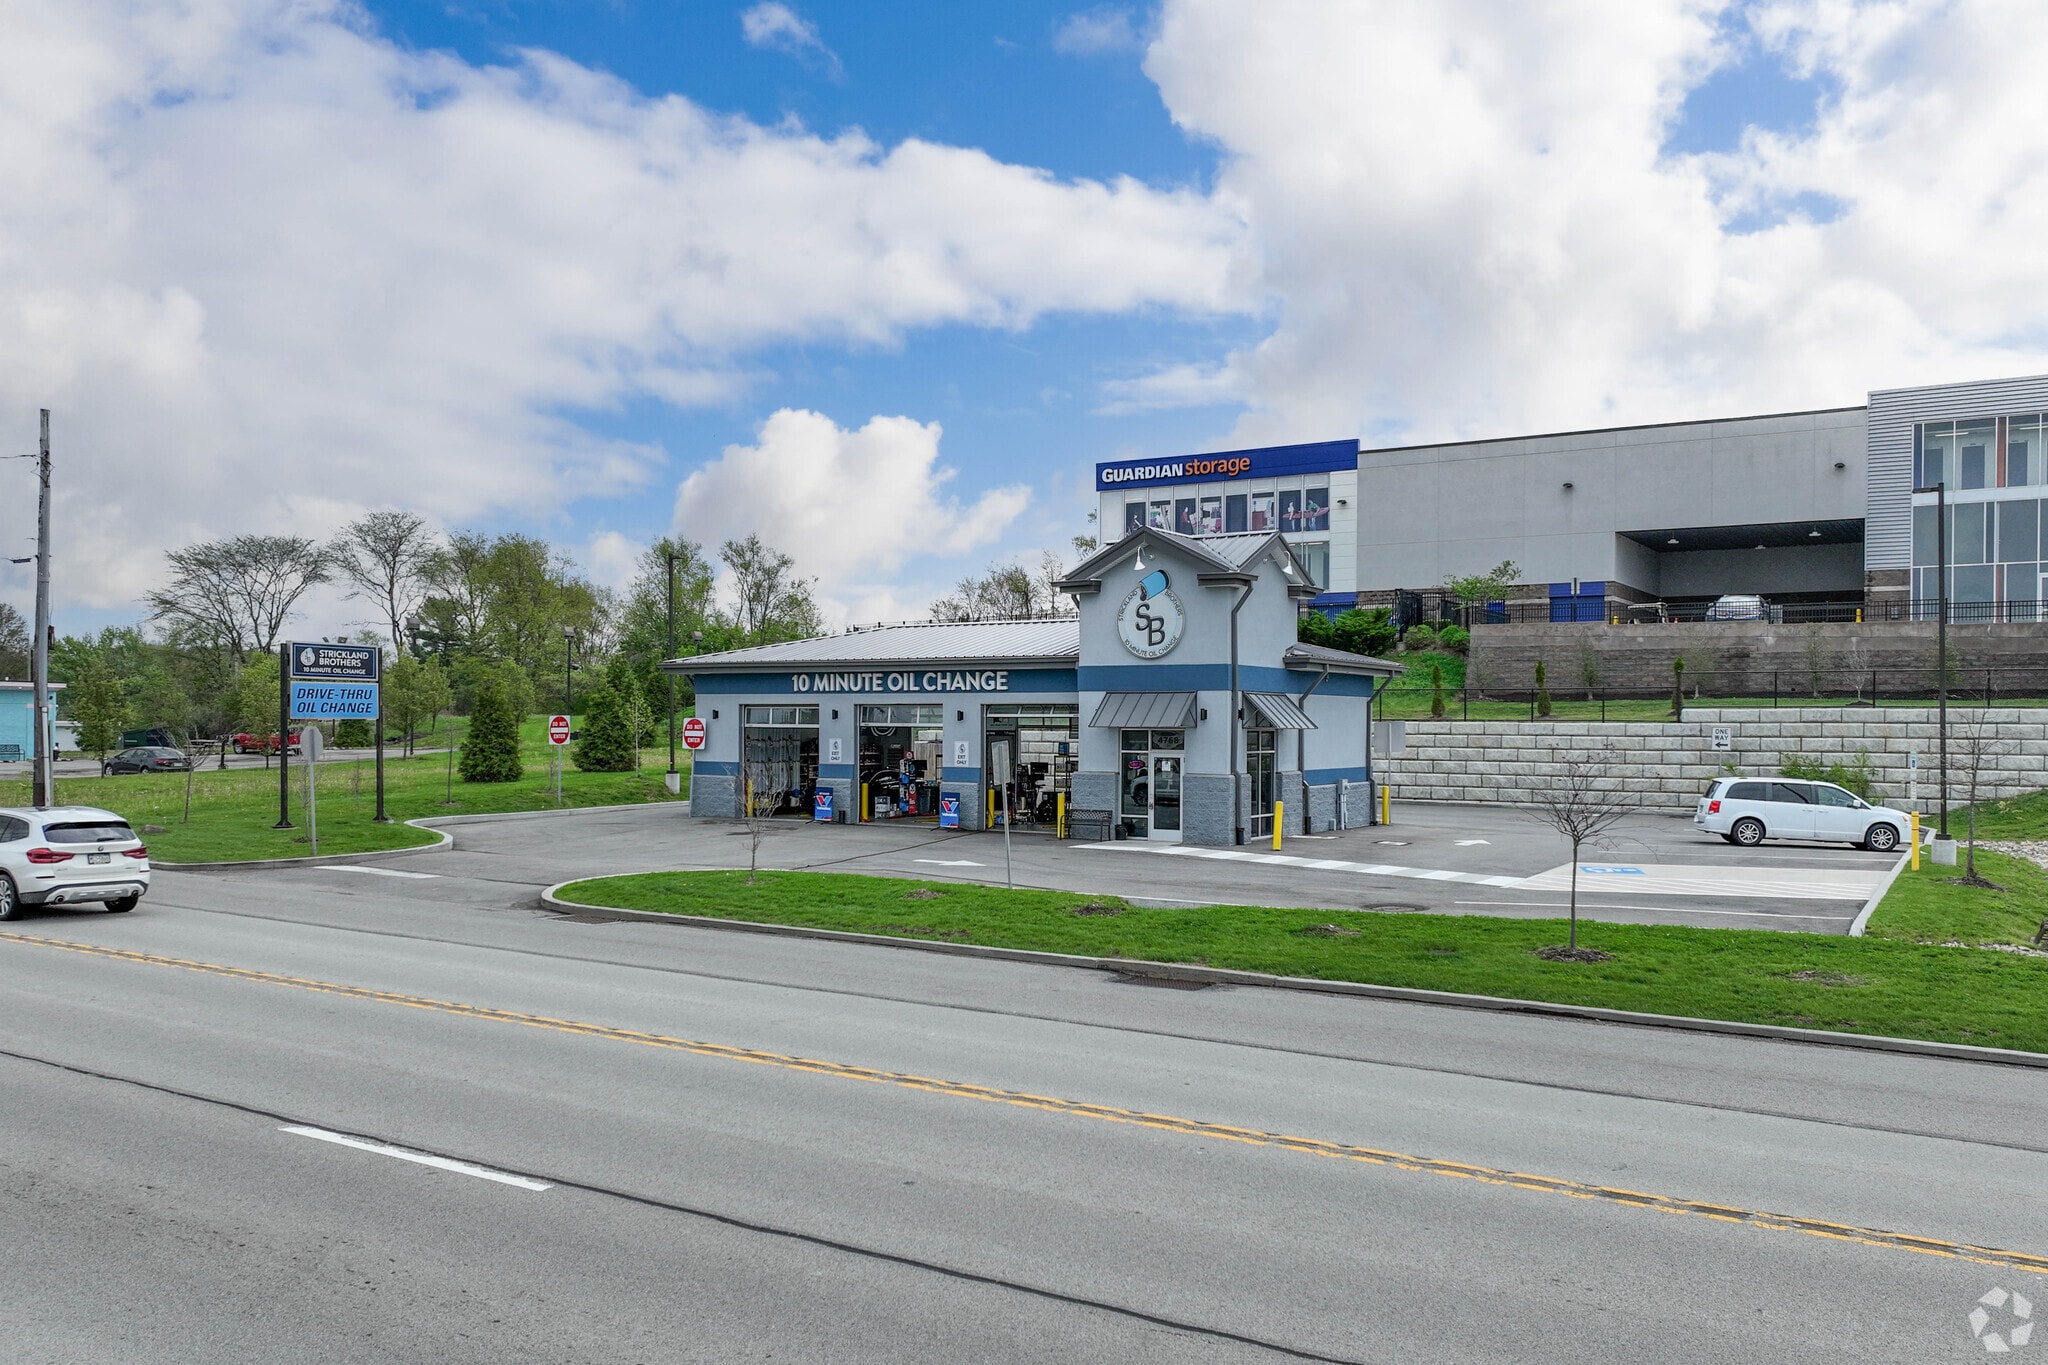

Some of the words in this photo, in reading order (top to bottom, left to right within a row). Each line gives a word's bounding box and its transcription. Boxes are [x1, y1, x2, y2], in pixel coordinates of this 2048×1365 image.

[1101, 463, 1184, 483] GUARDIAN
[1184, 457, 1251, 477] storage
[1119, 590, 1138, 621] STRICKLAND
[319, 649, 369, 660] STRICKLAND
[1128, 642, 1148, 657] MINUTE
[319, 658, 361, 667] BROTHERS
[791, 674, 810, 692] 10
[813, 673, 884, 692] MINUTE
[887, 673, 920, 692] OIL
[922, 671, 1009, 691] CHANGE
[296, 688, 373, 700] DRIVE-THRU
[296, 702, 317, 713] OIL
[320, 702, 373, 714] CHANGE
